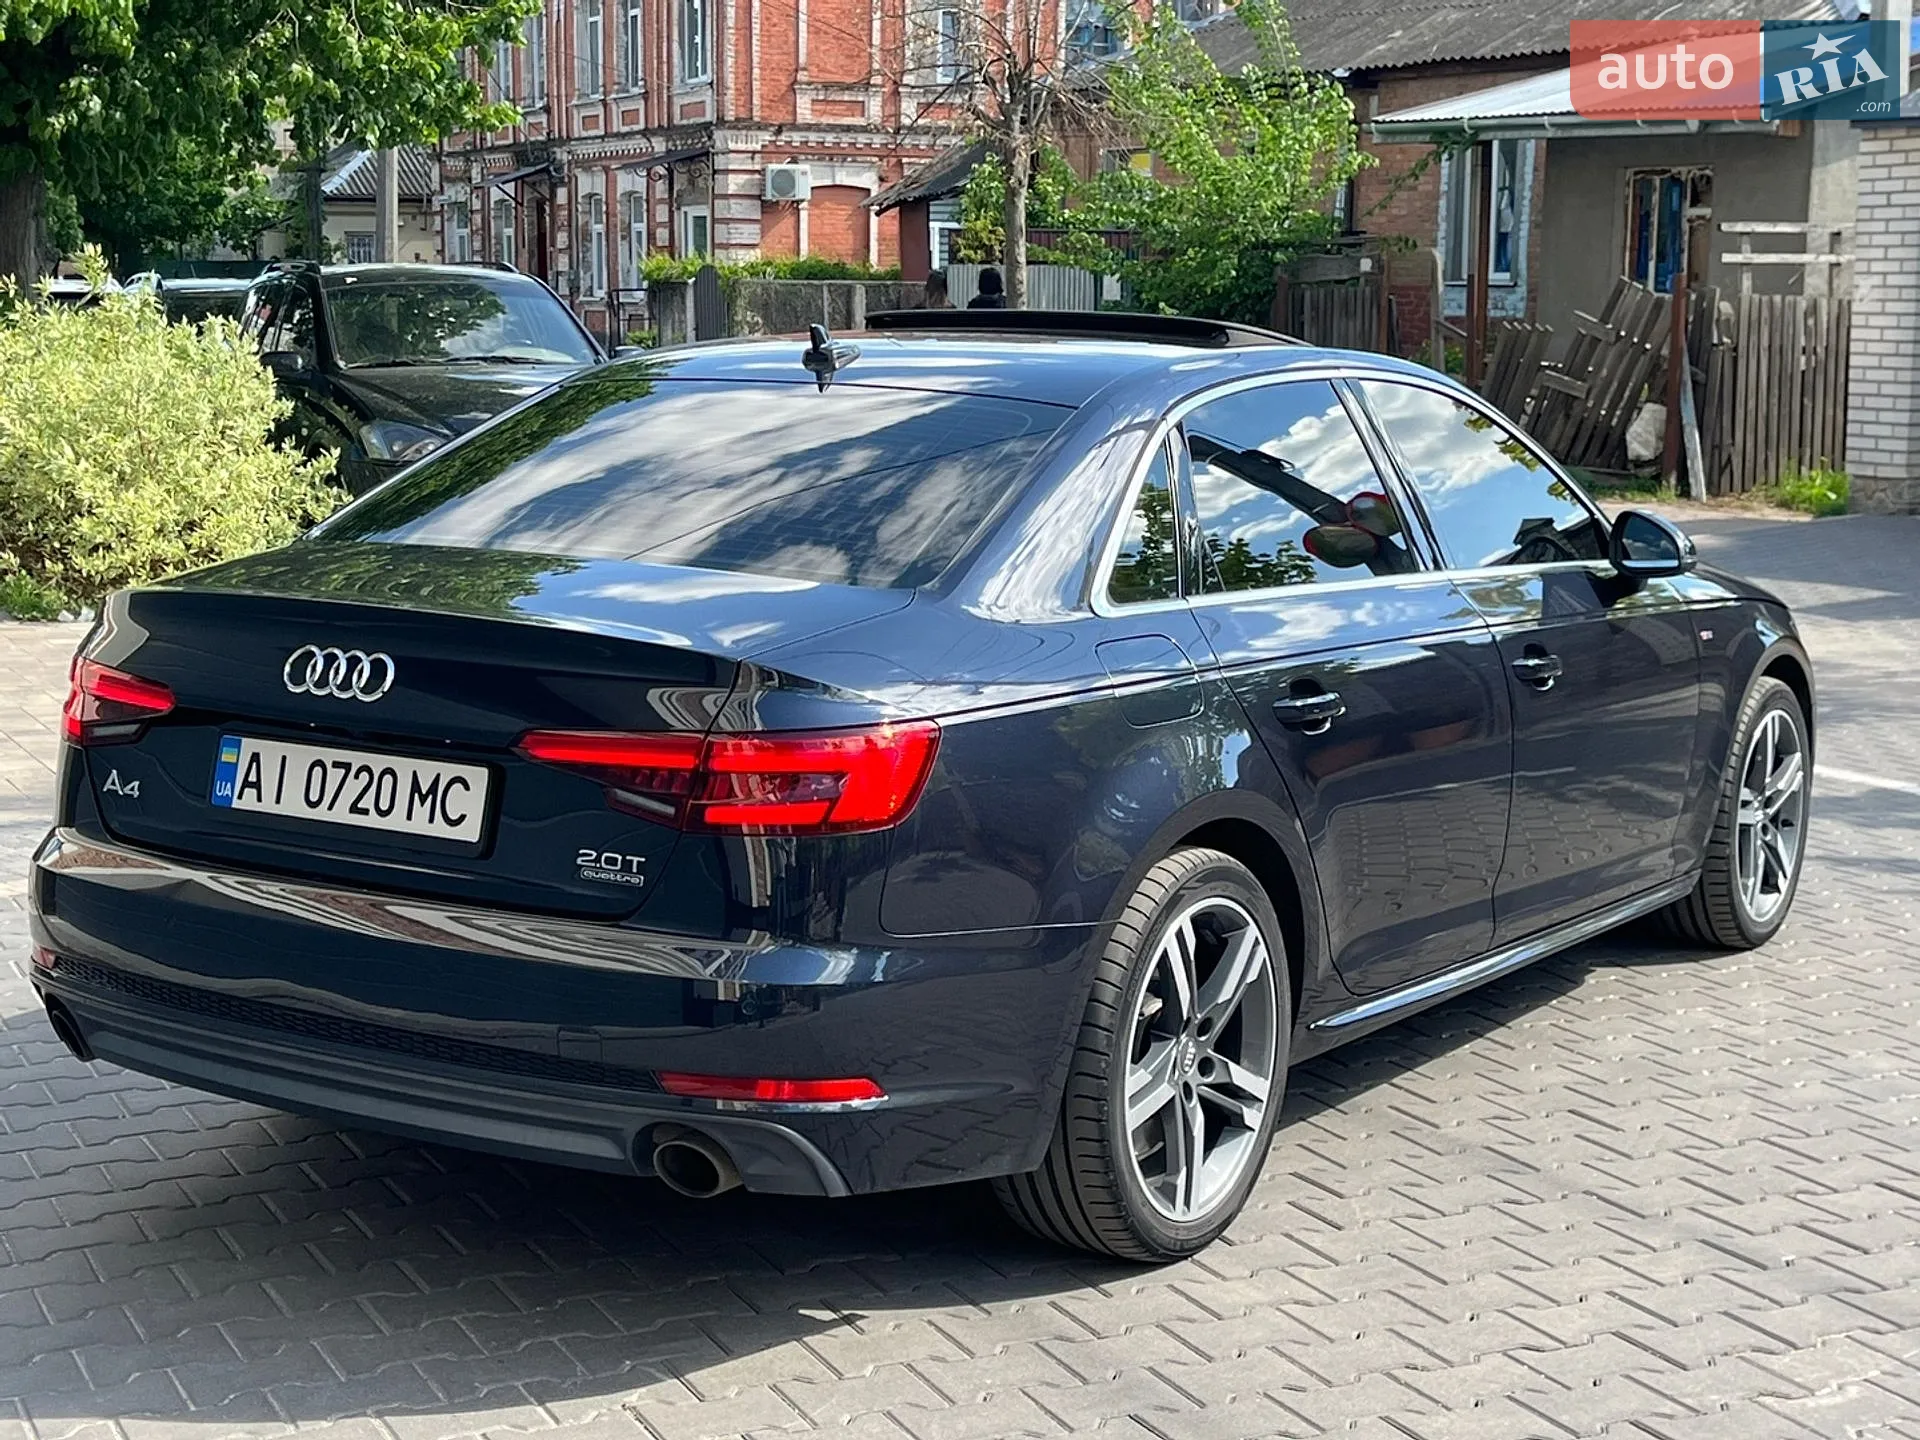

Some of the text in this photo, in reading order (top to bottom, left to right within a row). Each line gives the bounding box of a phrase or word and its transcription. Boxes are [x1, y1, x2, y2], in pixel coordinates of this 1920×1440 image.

[103, 769, 141, 798] A4
[216, 780, 231, 797] UA
[237, 752, 471, 828] AI 0720 MC
[576, 849, 646, 873] 2.0T
[583, 870, 640, 883] quattro
